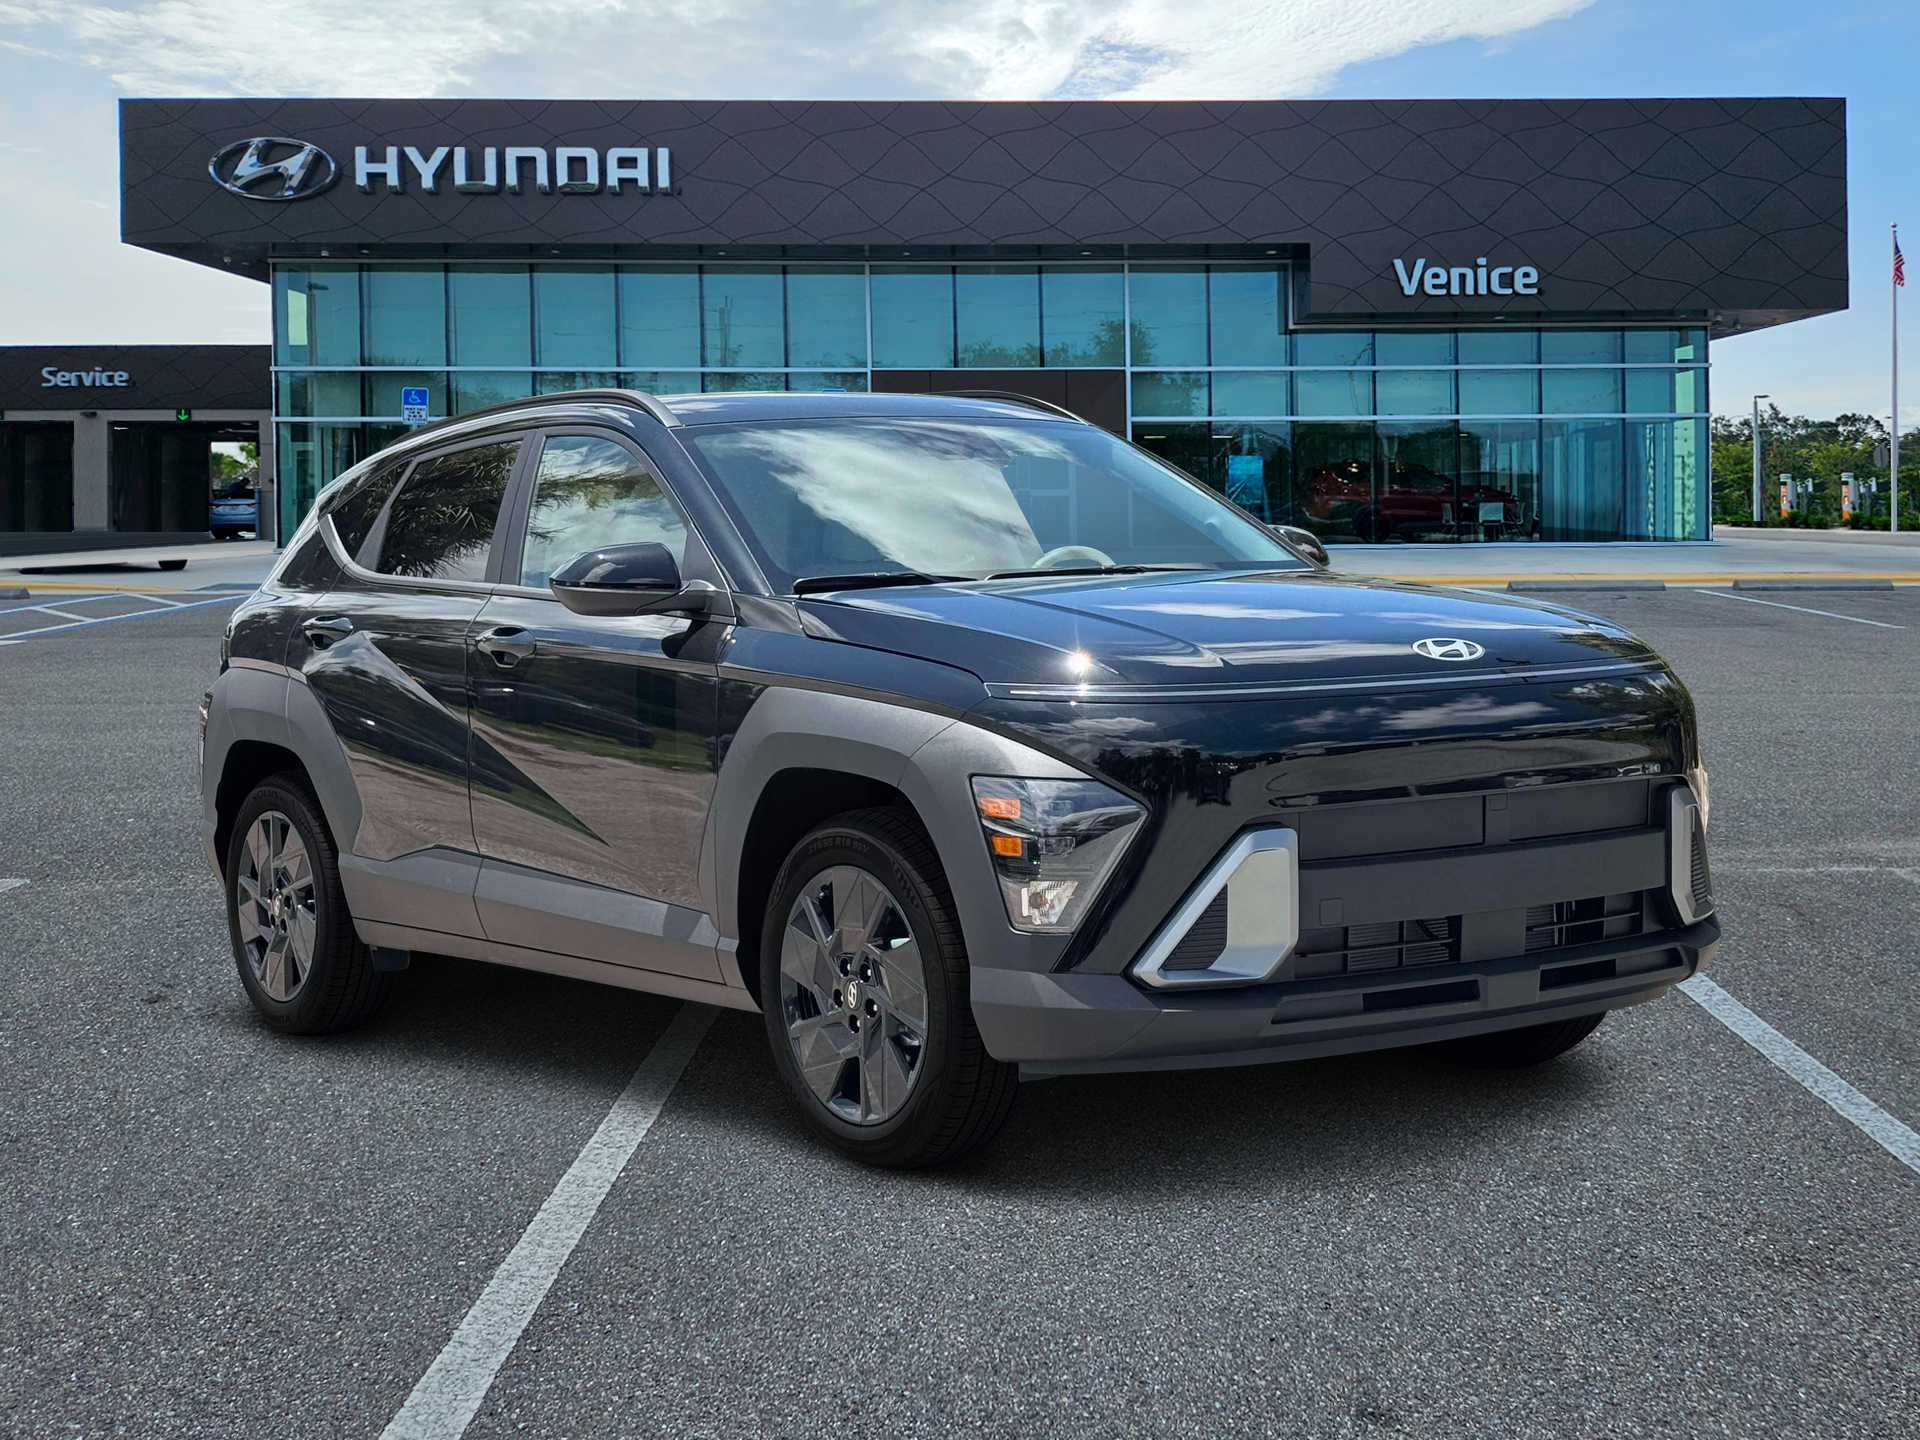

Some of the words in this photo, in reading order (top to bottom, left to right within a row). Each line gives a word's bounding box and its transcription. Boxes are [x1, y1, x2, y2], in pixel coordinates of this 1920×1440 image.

[353, 146, 671, 194] HYUNDAI
[1393, 257, 1539, 296] Venice
[41, 366, 130, 387] Service
[252, 789, 279, 803] SOLUS
[835, 837, 851, 847] R18
[852, 840, 870, 854] 95V
[927, 952, 943, 1050] KUMHO
[260, 1008, 291, 1024] KUMHO
